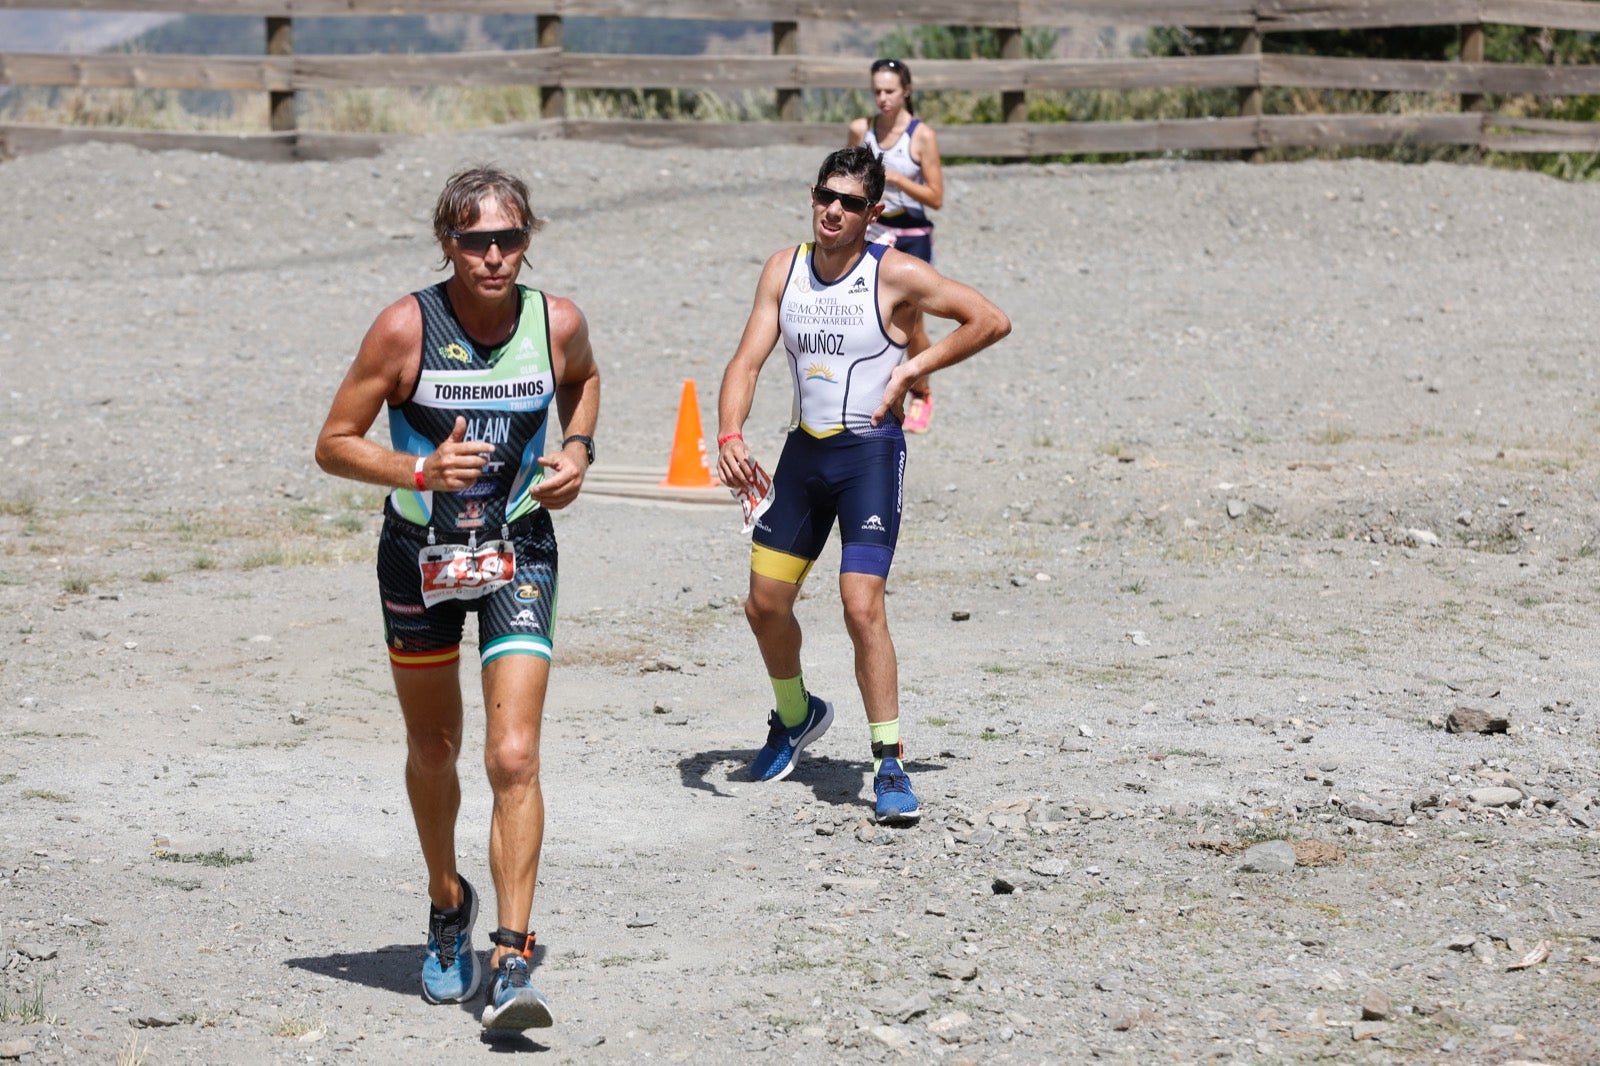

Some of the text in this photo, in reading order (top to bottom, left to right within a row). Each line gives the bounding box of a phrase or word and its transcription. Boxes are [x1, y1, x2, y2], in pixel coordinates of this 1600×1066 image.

[814, 297, 837, 305] HOTEL
[798, 304, 864, 315] MONTEROS
[821, 316, 864, 326] MARBELLA
[797, 329, 845, 356] MUÑOZ
[434, 380, 544, 400] TORREMOLINOS
[463, 416, 511, 444] ALAIN
